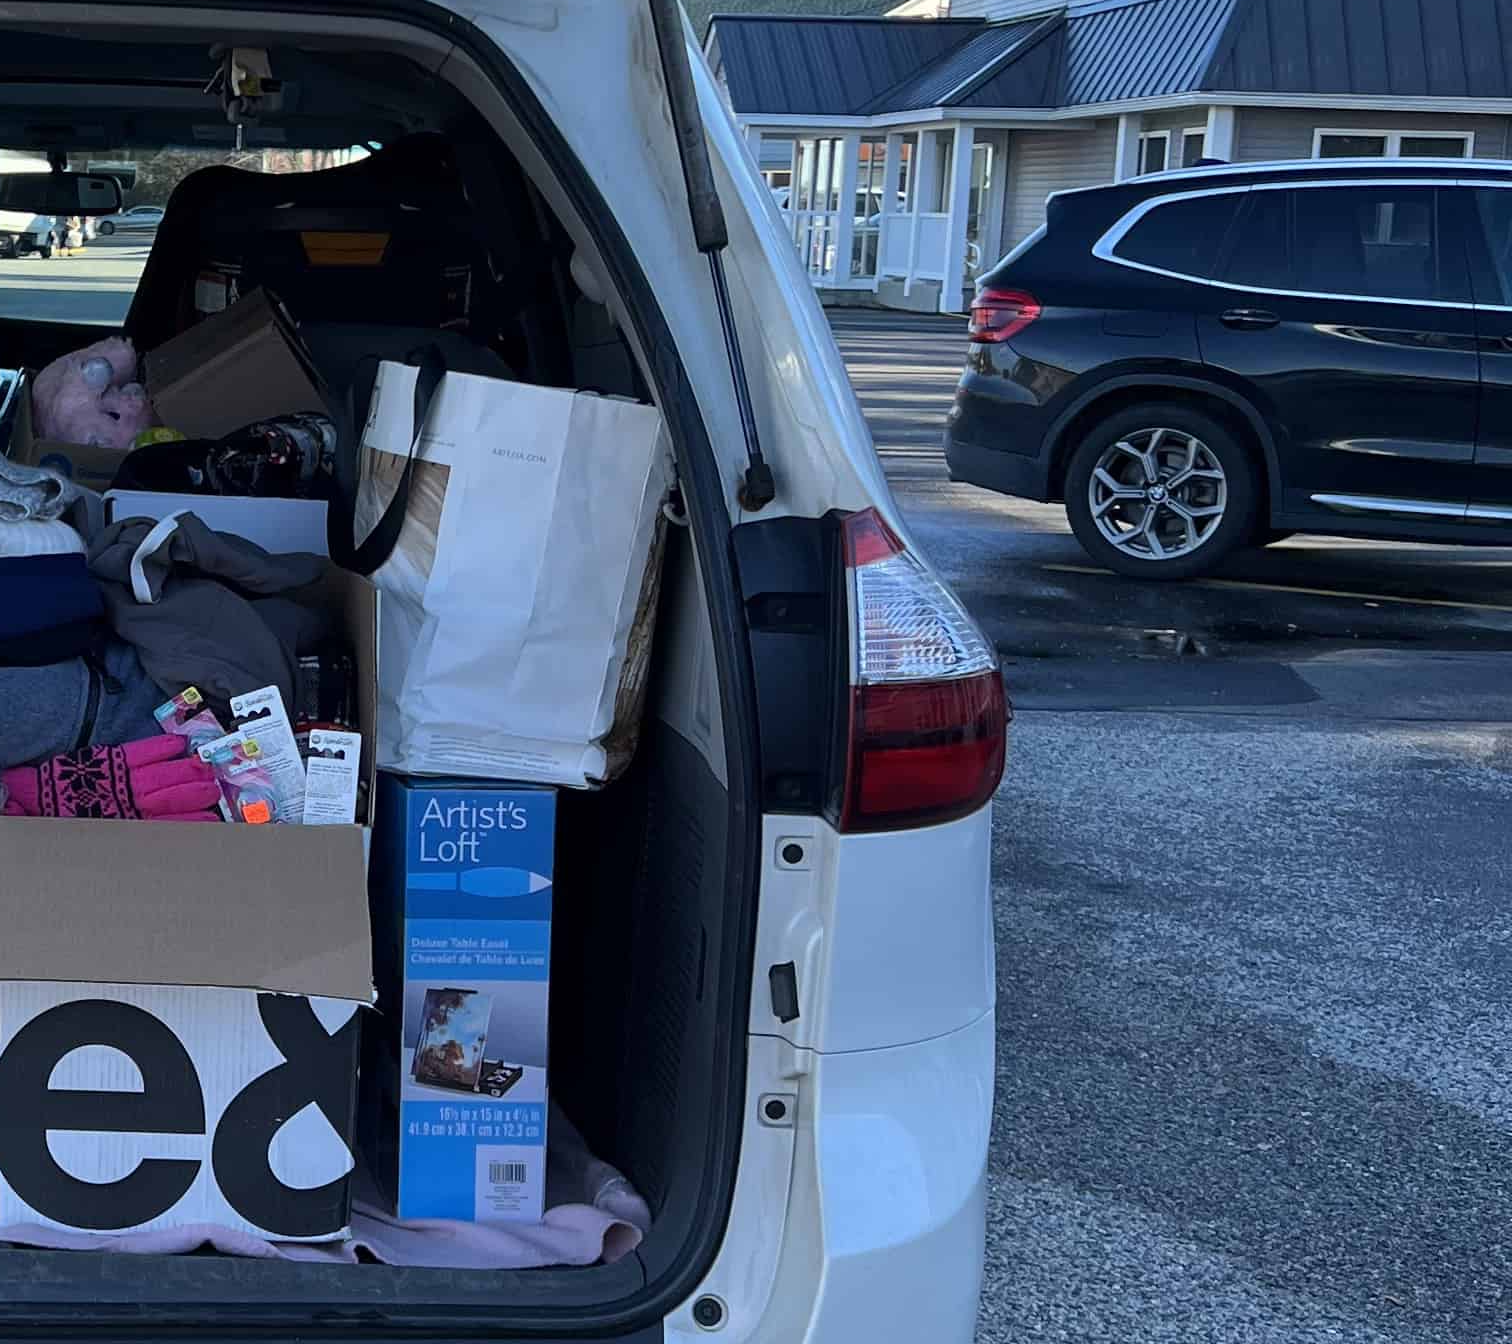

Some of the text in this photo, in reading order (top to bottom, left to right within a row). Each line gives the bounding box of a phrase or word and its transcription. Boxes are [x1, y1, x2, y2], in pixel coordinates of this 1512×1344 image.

[419, 797, 528, 830] Artist's
[481, 1108, 492, 1121] 15
[408, 1122, 429, 1135] 41.9
[431, 1124, 445, 1136] cm
[478, 1125, 493, 1136] cm
[526, 1125, 539, 1136] cm
